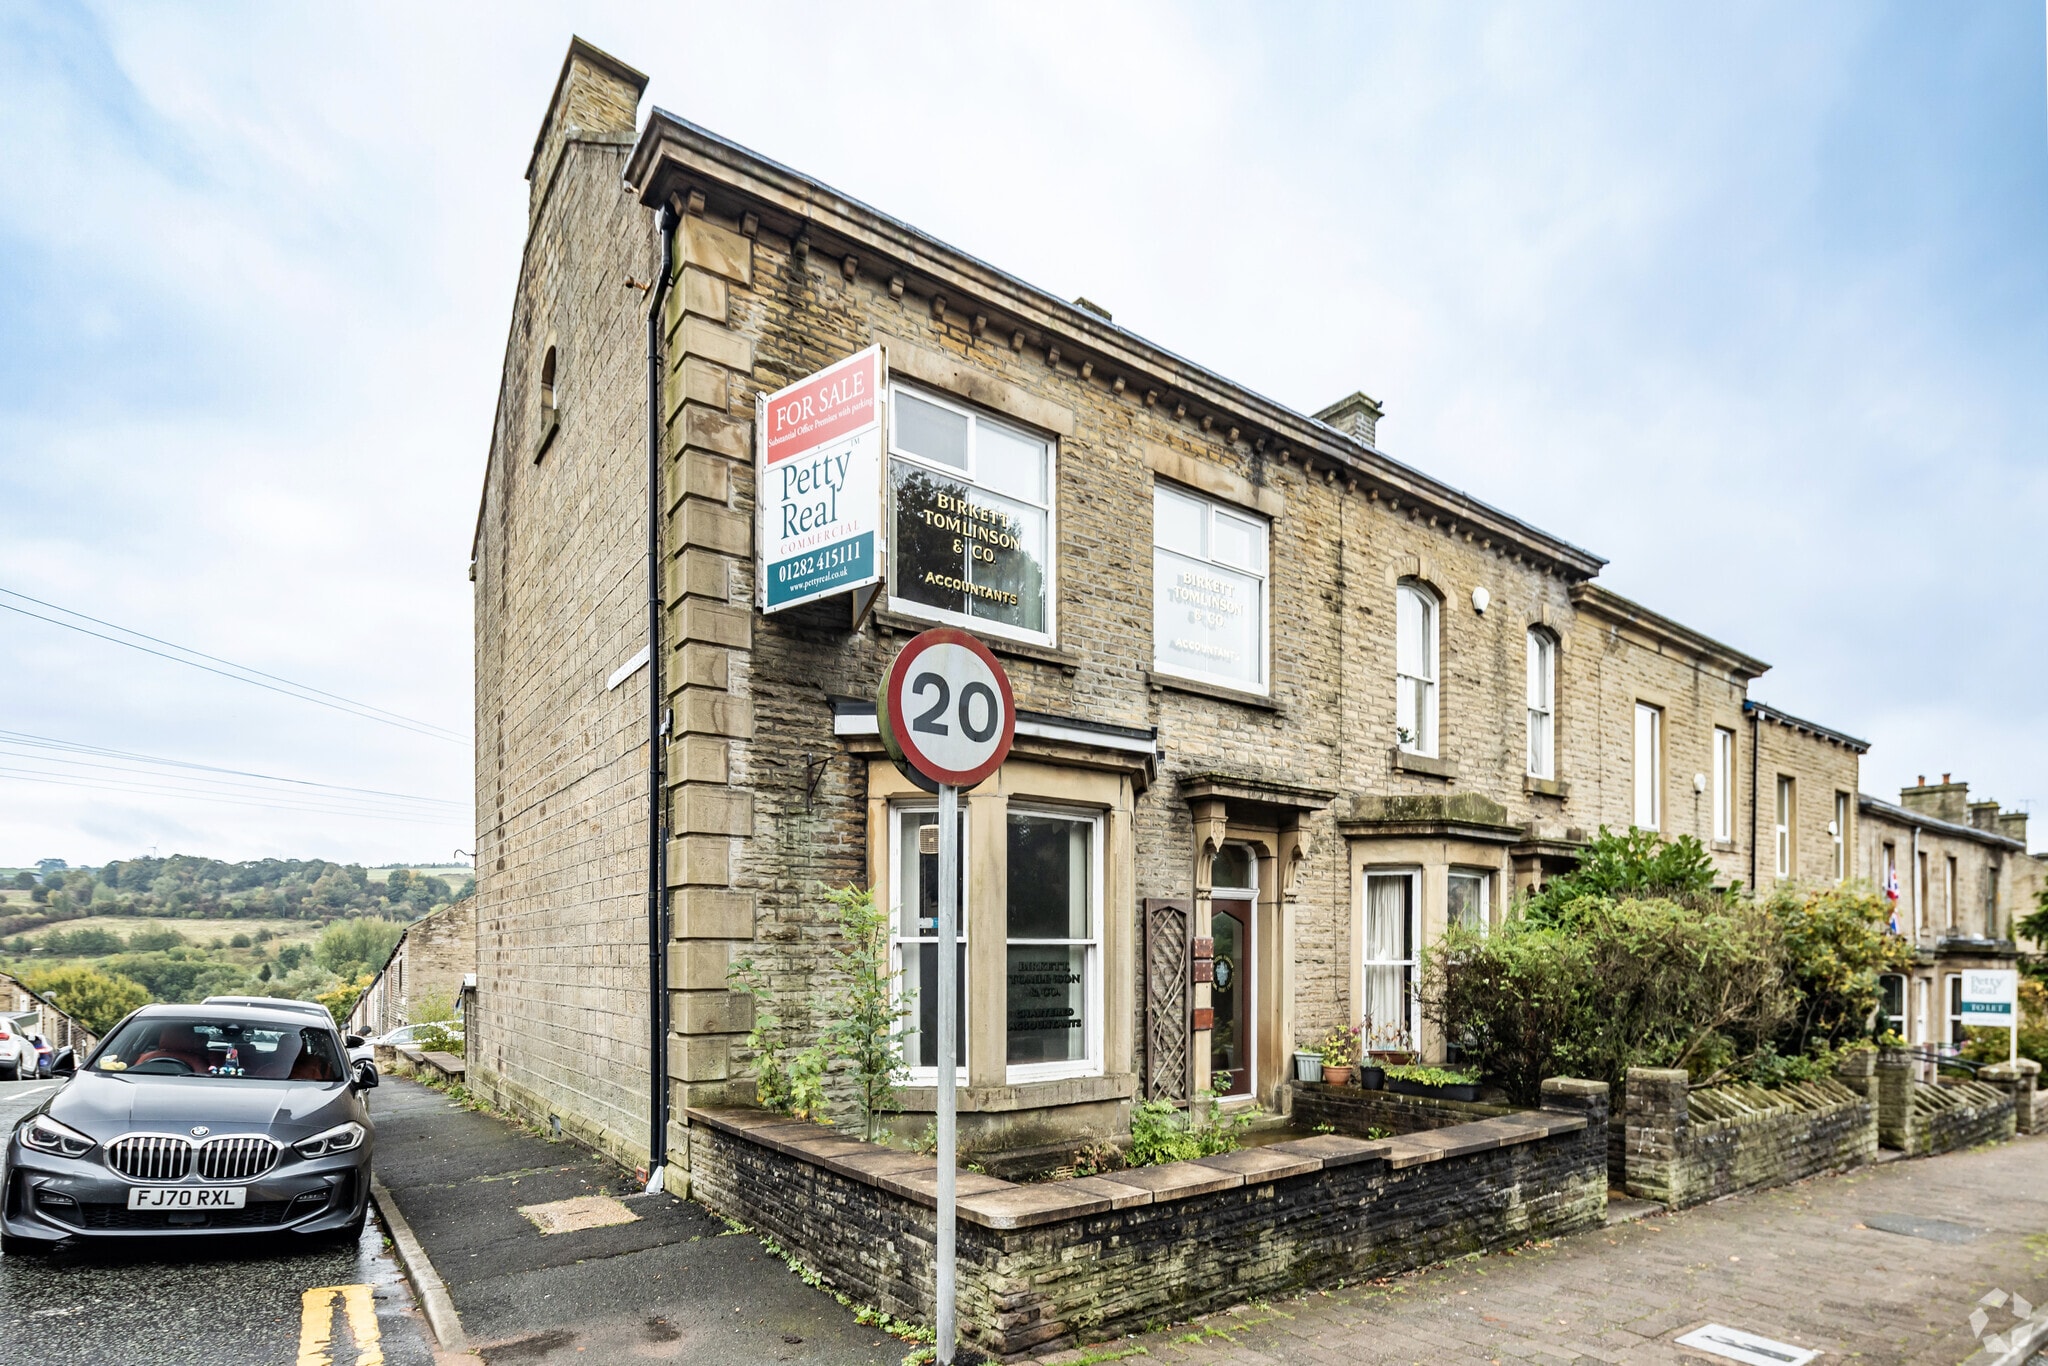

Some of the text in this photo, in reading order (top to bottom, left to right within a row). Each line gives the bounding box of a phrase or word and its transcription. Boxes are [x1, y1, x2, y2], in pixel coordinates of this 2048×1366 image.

[776, 370, 865, 432] FOR SALE
[797, 421, 814, 436] Office
[814, 413, 837, 430] Premises
[838, 405, 851, 417] with
[851, 397, 874, 416] parking
[781, 450, 852, 502] Petty
[781, 483, 838, 540] Real
[923, 509, 1021, 551] TOMLINSON
[780, 519, 860, 555] COMMERCIAL
[952, 539, 997, 565] & CO.
[779, 541, 860, 583] 01282 415111
[789, 566, 848, 592] www.pettyreal.co.uk
[924, 571, 1018, 606] ACCOUNTANTS
[1174, 585, 1244, 616] TOMLINSON
[912, 672, 999, 743] 20
[136, 1190, 236, 1206] FJ70 RXL
